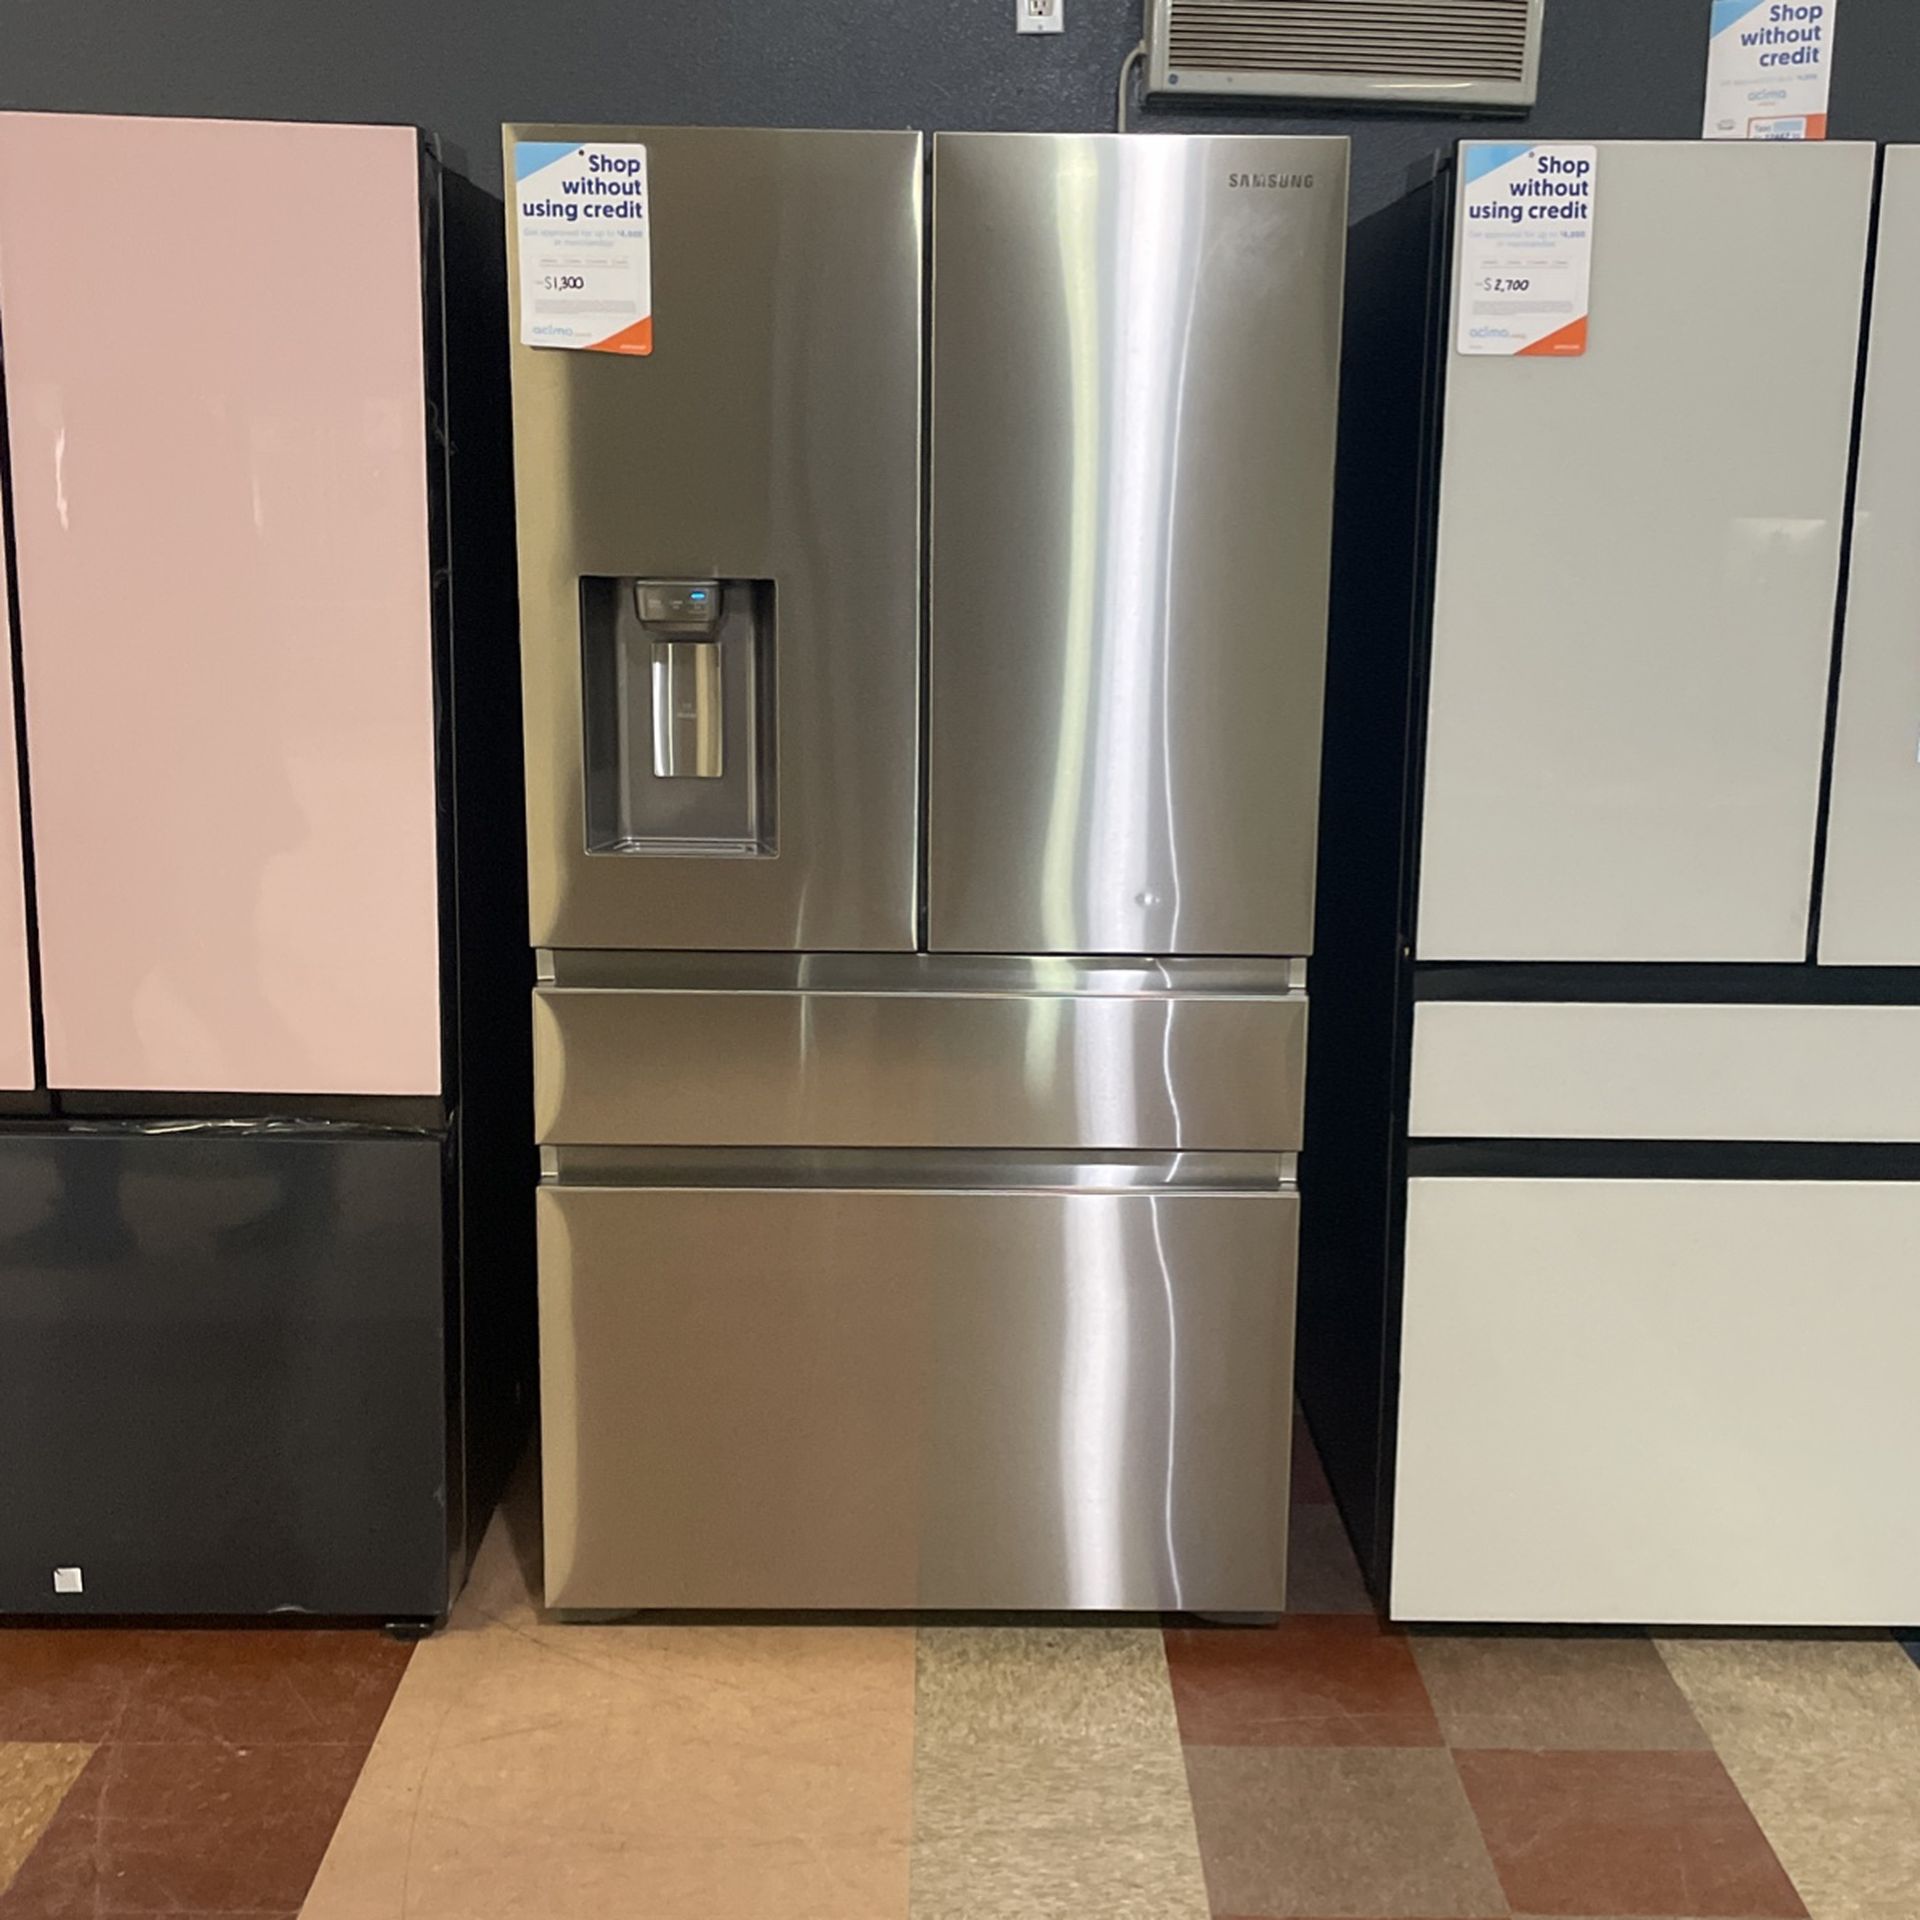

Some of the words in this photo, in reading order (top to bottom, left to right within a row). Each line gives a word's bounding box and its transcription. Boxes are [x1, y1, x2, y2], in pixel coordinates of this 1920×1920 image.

[1769, 4, 1823, 23] Shop
[1741, 26, 1822, 46] without
[1759, 46, 1820, 67] credit
[588, 154, 641, 177] Shop
[1537, 156, 1590, 178] Shop
[562, 177, 642, 195] without
[1228, 173, 1314, 188] SAMSUNG
[1509, 178, 1589, 196] without
[522, 199, 579, 221] using
[583, 200, 643, 219] credit
[1469, 201, 1523, 223] using
[1528, 201, 1588, 219] credit
